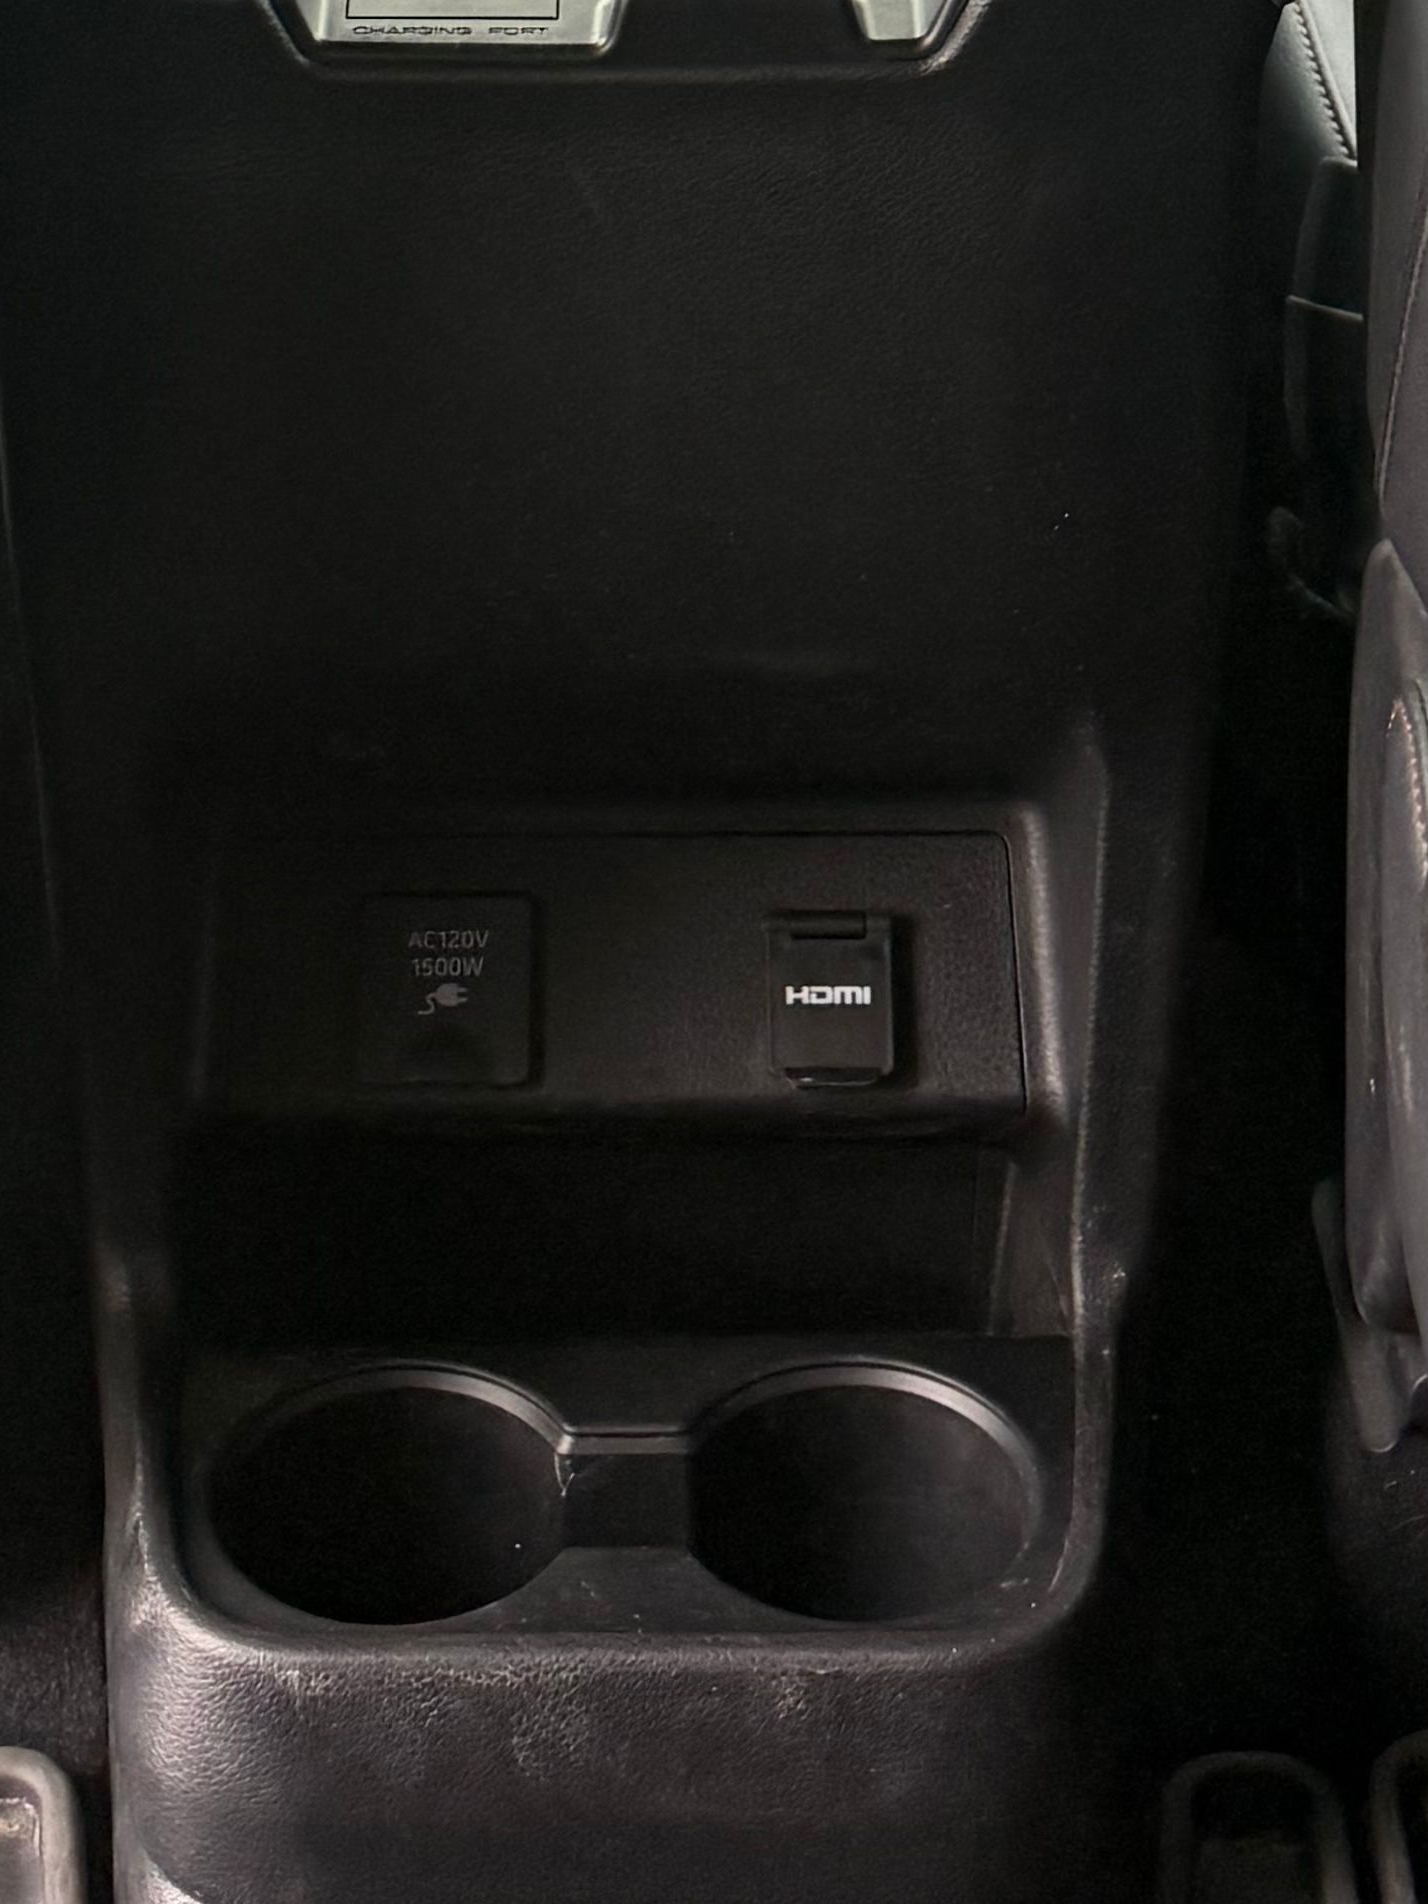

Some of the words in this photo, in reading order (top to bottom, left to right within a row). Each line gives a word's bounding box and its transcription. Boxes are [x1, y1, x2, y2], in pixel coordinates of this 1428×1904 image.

[351, 25, 473, 36] CHARGING
[487, 25, 549, 36] PORT
[408, 929, 489, 948] AC120V
[412, 956, 484, 977] 1500W
[785, 985, 871, 1005] HDMI
